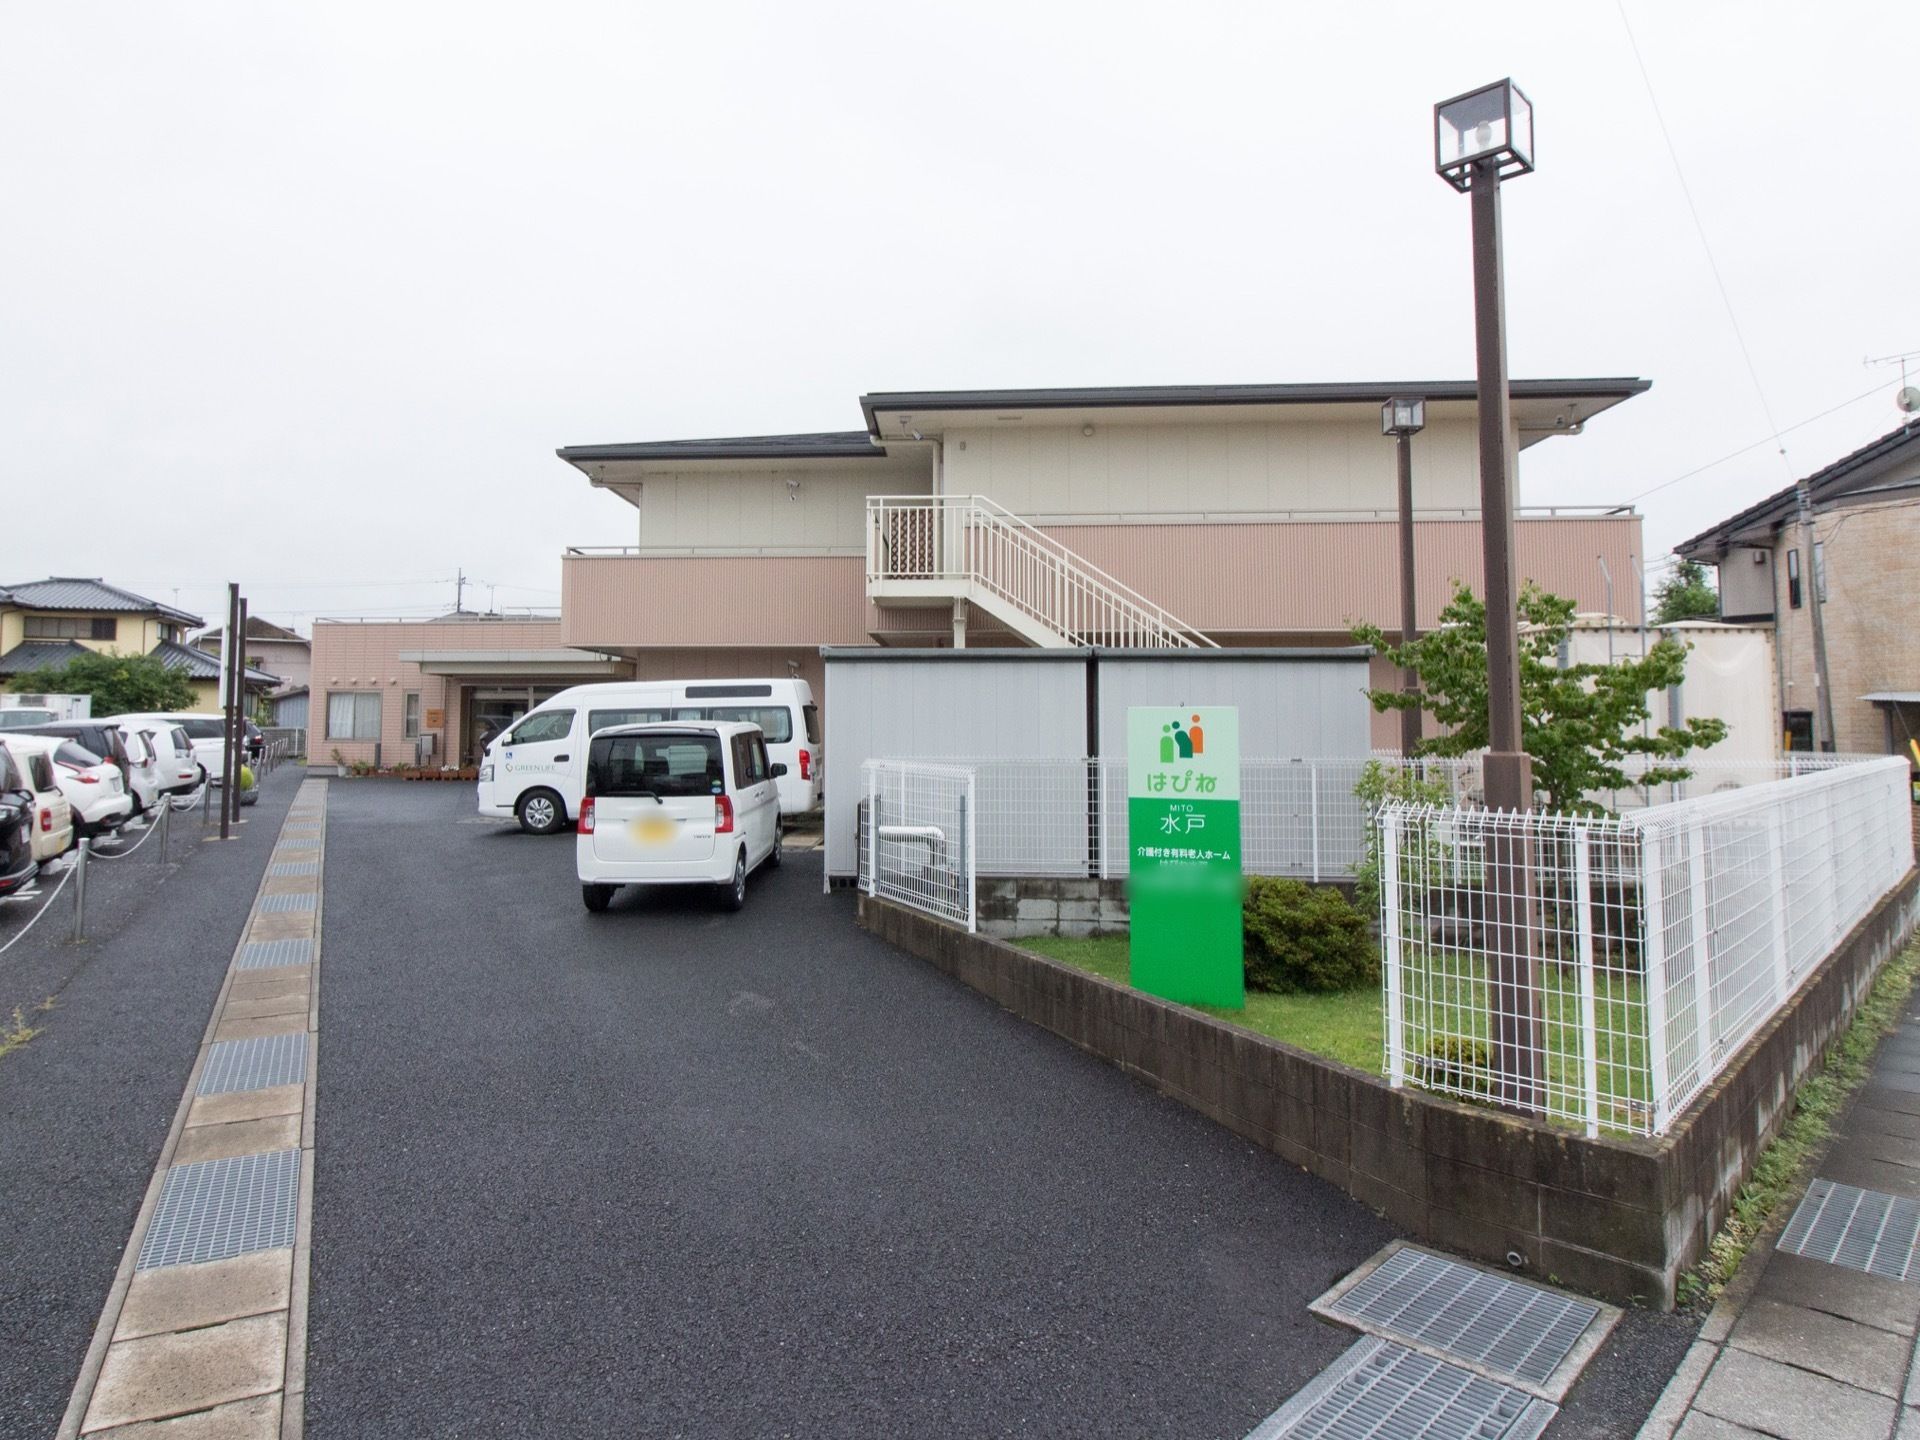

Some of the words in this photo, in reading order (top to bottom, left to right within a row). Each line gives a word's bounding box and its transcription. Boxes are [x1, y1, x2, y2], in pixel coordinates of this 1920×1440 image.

[1147, 770, 1217, 793] はぴね
[1170, 804, 1193, 812] MITO
[1160, 813, 1206, 834] 水戸
[1137, 846, 1231, 860] 介護付き有料老人ホーム
